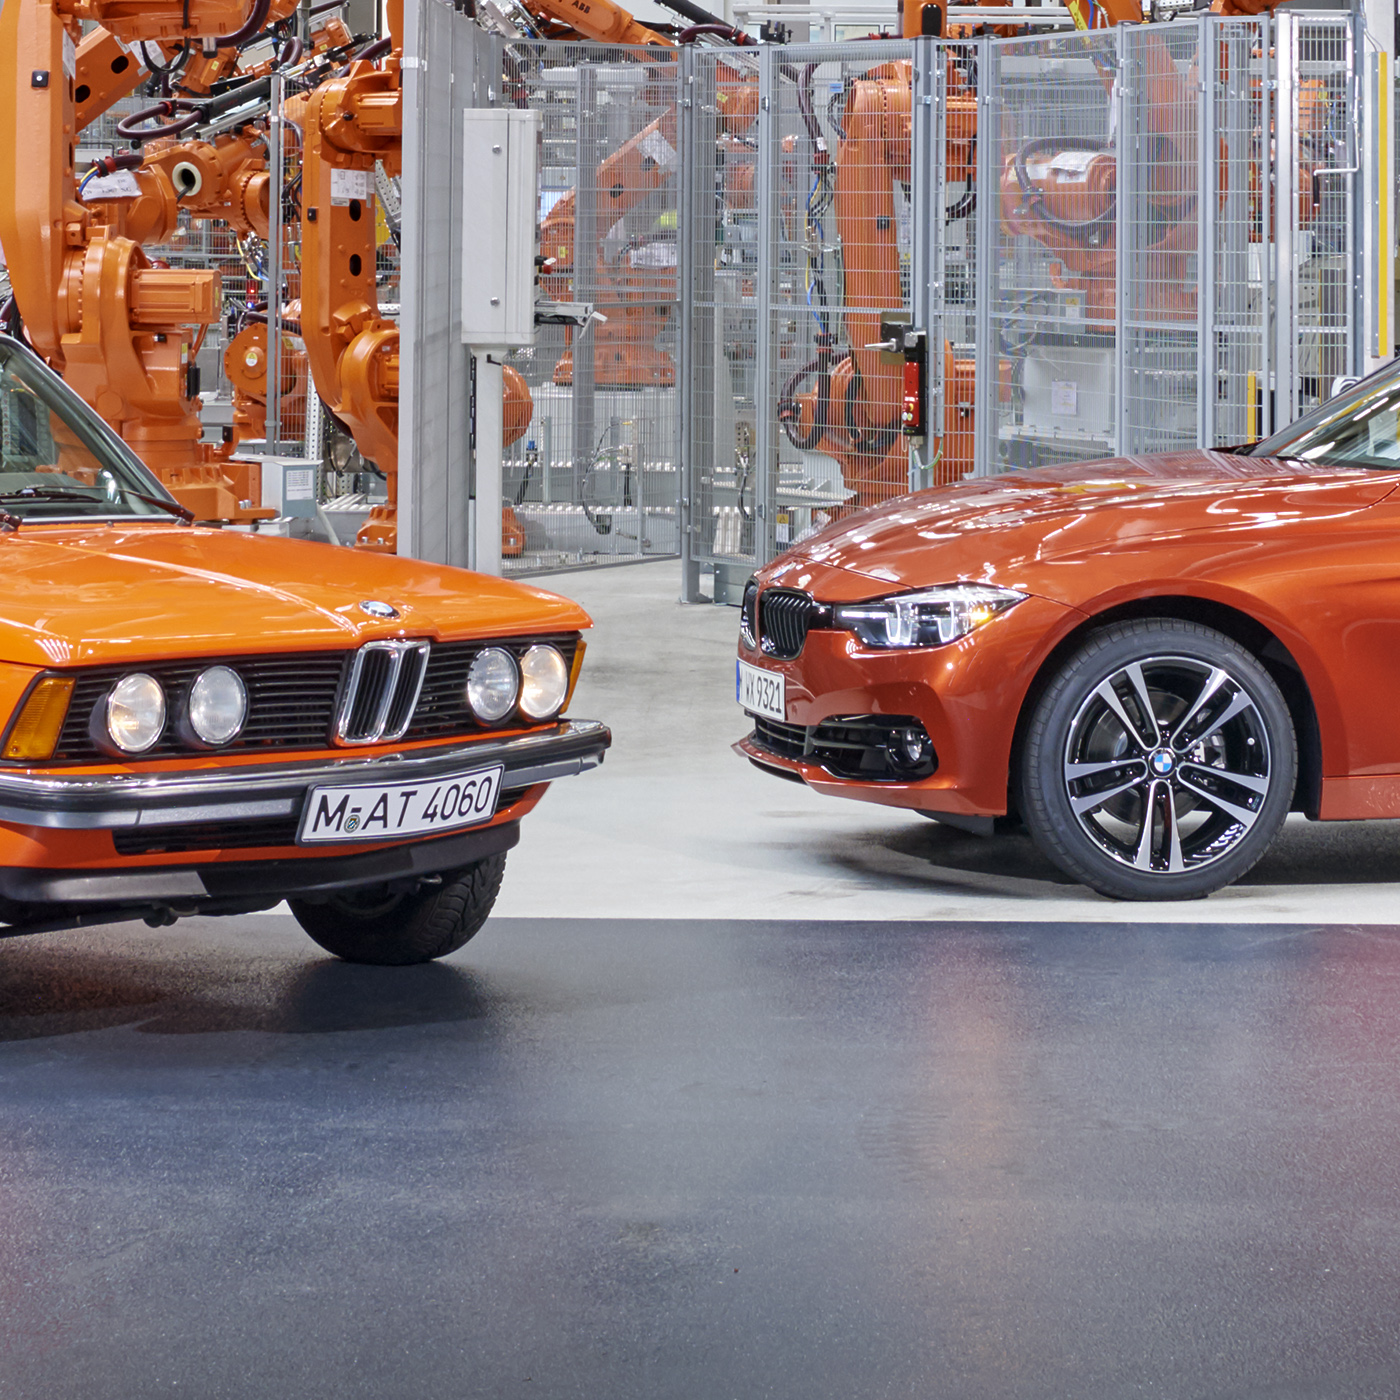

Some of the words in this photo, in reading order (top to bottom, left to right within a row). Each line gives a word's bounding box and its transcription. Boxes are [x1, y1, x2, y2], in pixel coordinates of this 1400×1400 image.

[571, 0, 591, 14] ABB
[756, 675, 782, 714] 9321
[421, 776, 493, 823] 4060
